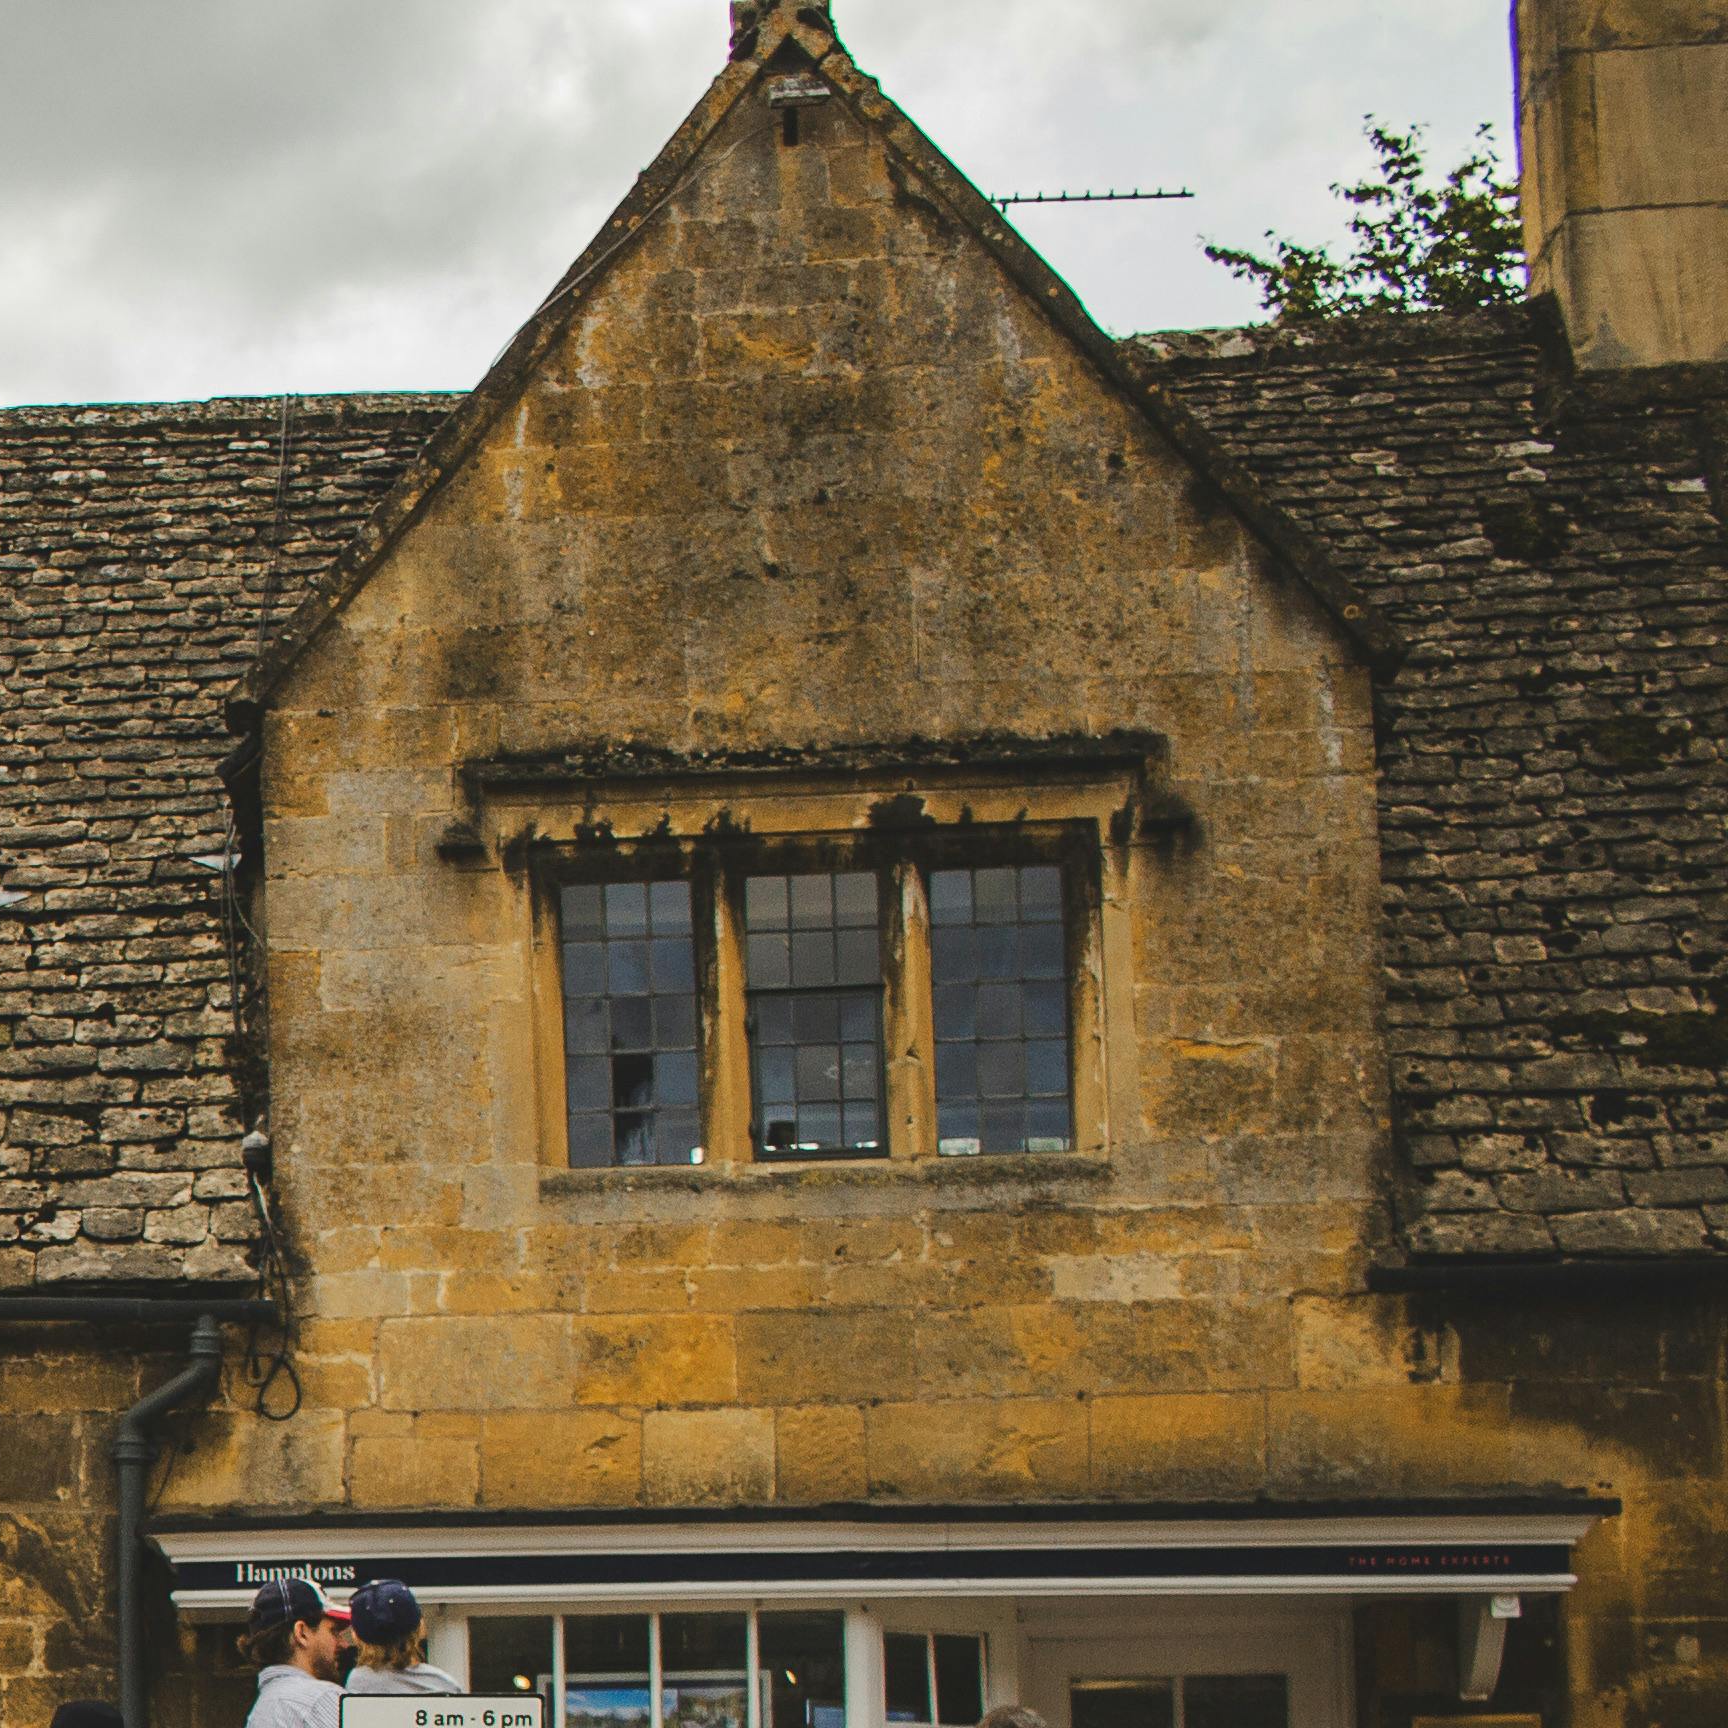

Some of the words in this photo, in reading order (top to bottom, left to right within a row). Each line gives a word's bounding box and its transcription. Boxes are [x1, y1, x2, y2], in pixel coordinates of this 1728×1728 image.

[236, 1562, 356, 1583] Hamptons
[415, 1710, 427, 1726] 8
[434, 1713, 464, 1726] am
[482, 1710, 495, 1726] 6
[501, 1713, 532, 1728] pm
